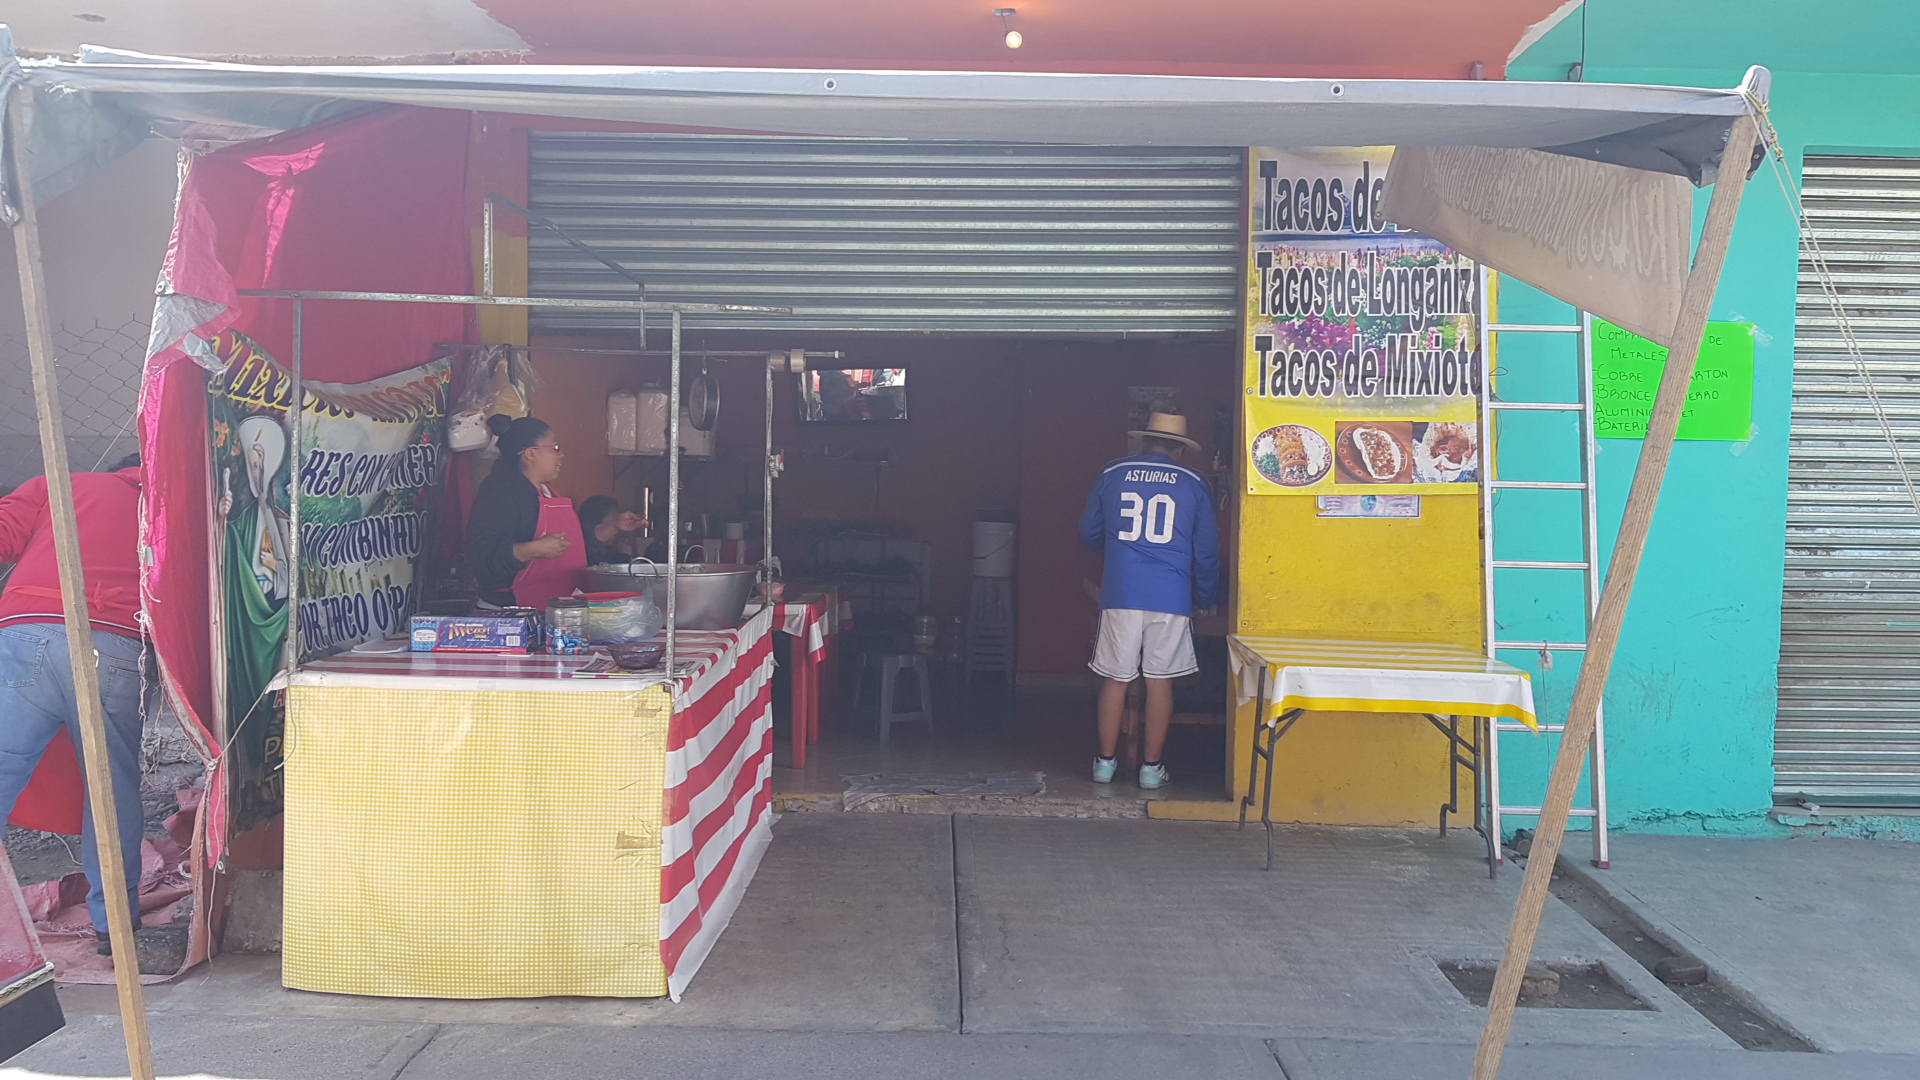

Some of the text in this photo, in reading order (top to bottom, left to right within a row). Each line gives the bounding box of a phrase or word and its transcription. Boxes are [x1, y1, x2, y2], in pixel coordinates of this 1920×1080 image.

[1259, 160, 1346, 233] Tacos
[1257, 251, 1475, 331] Tacos de Longaniz
[1598, 323, 1722, 346] COMP DE
[1611, 347, 1667, 362] METALES
[1254, 335, 1337, 398] Tacos
[1342, 334, 1380, 398] de
[1690, 369, 1728, 382] ARTON
[1682, 409, 1694, 418] ET
[1685, 390, 1719, 401] IERRO
[300, 448, 353, 498] RES
[1124, 469, 1178, 484] ASTURIAS
[1118, 492, 1176, 544] 30
[302, 522, 323, 571] Y
[299, 600, 328, 653] OR
[321, 592, 369, 646] TACO
[371, 586, 390, 633] O
